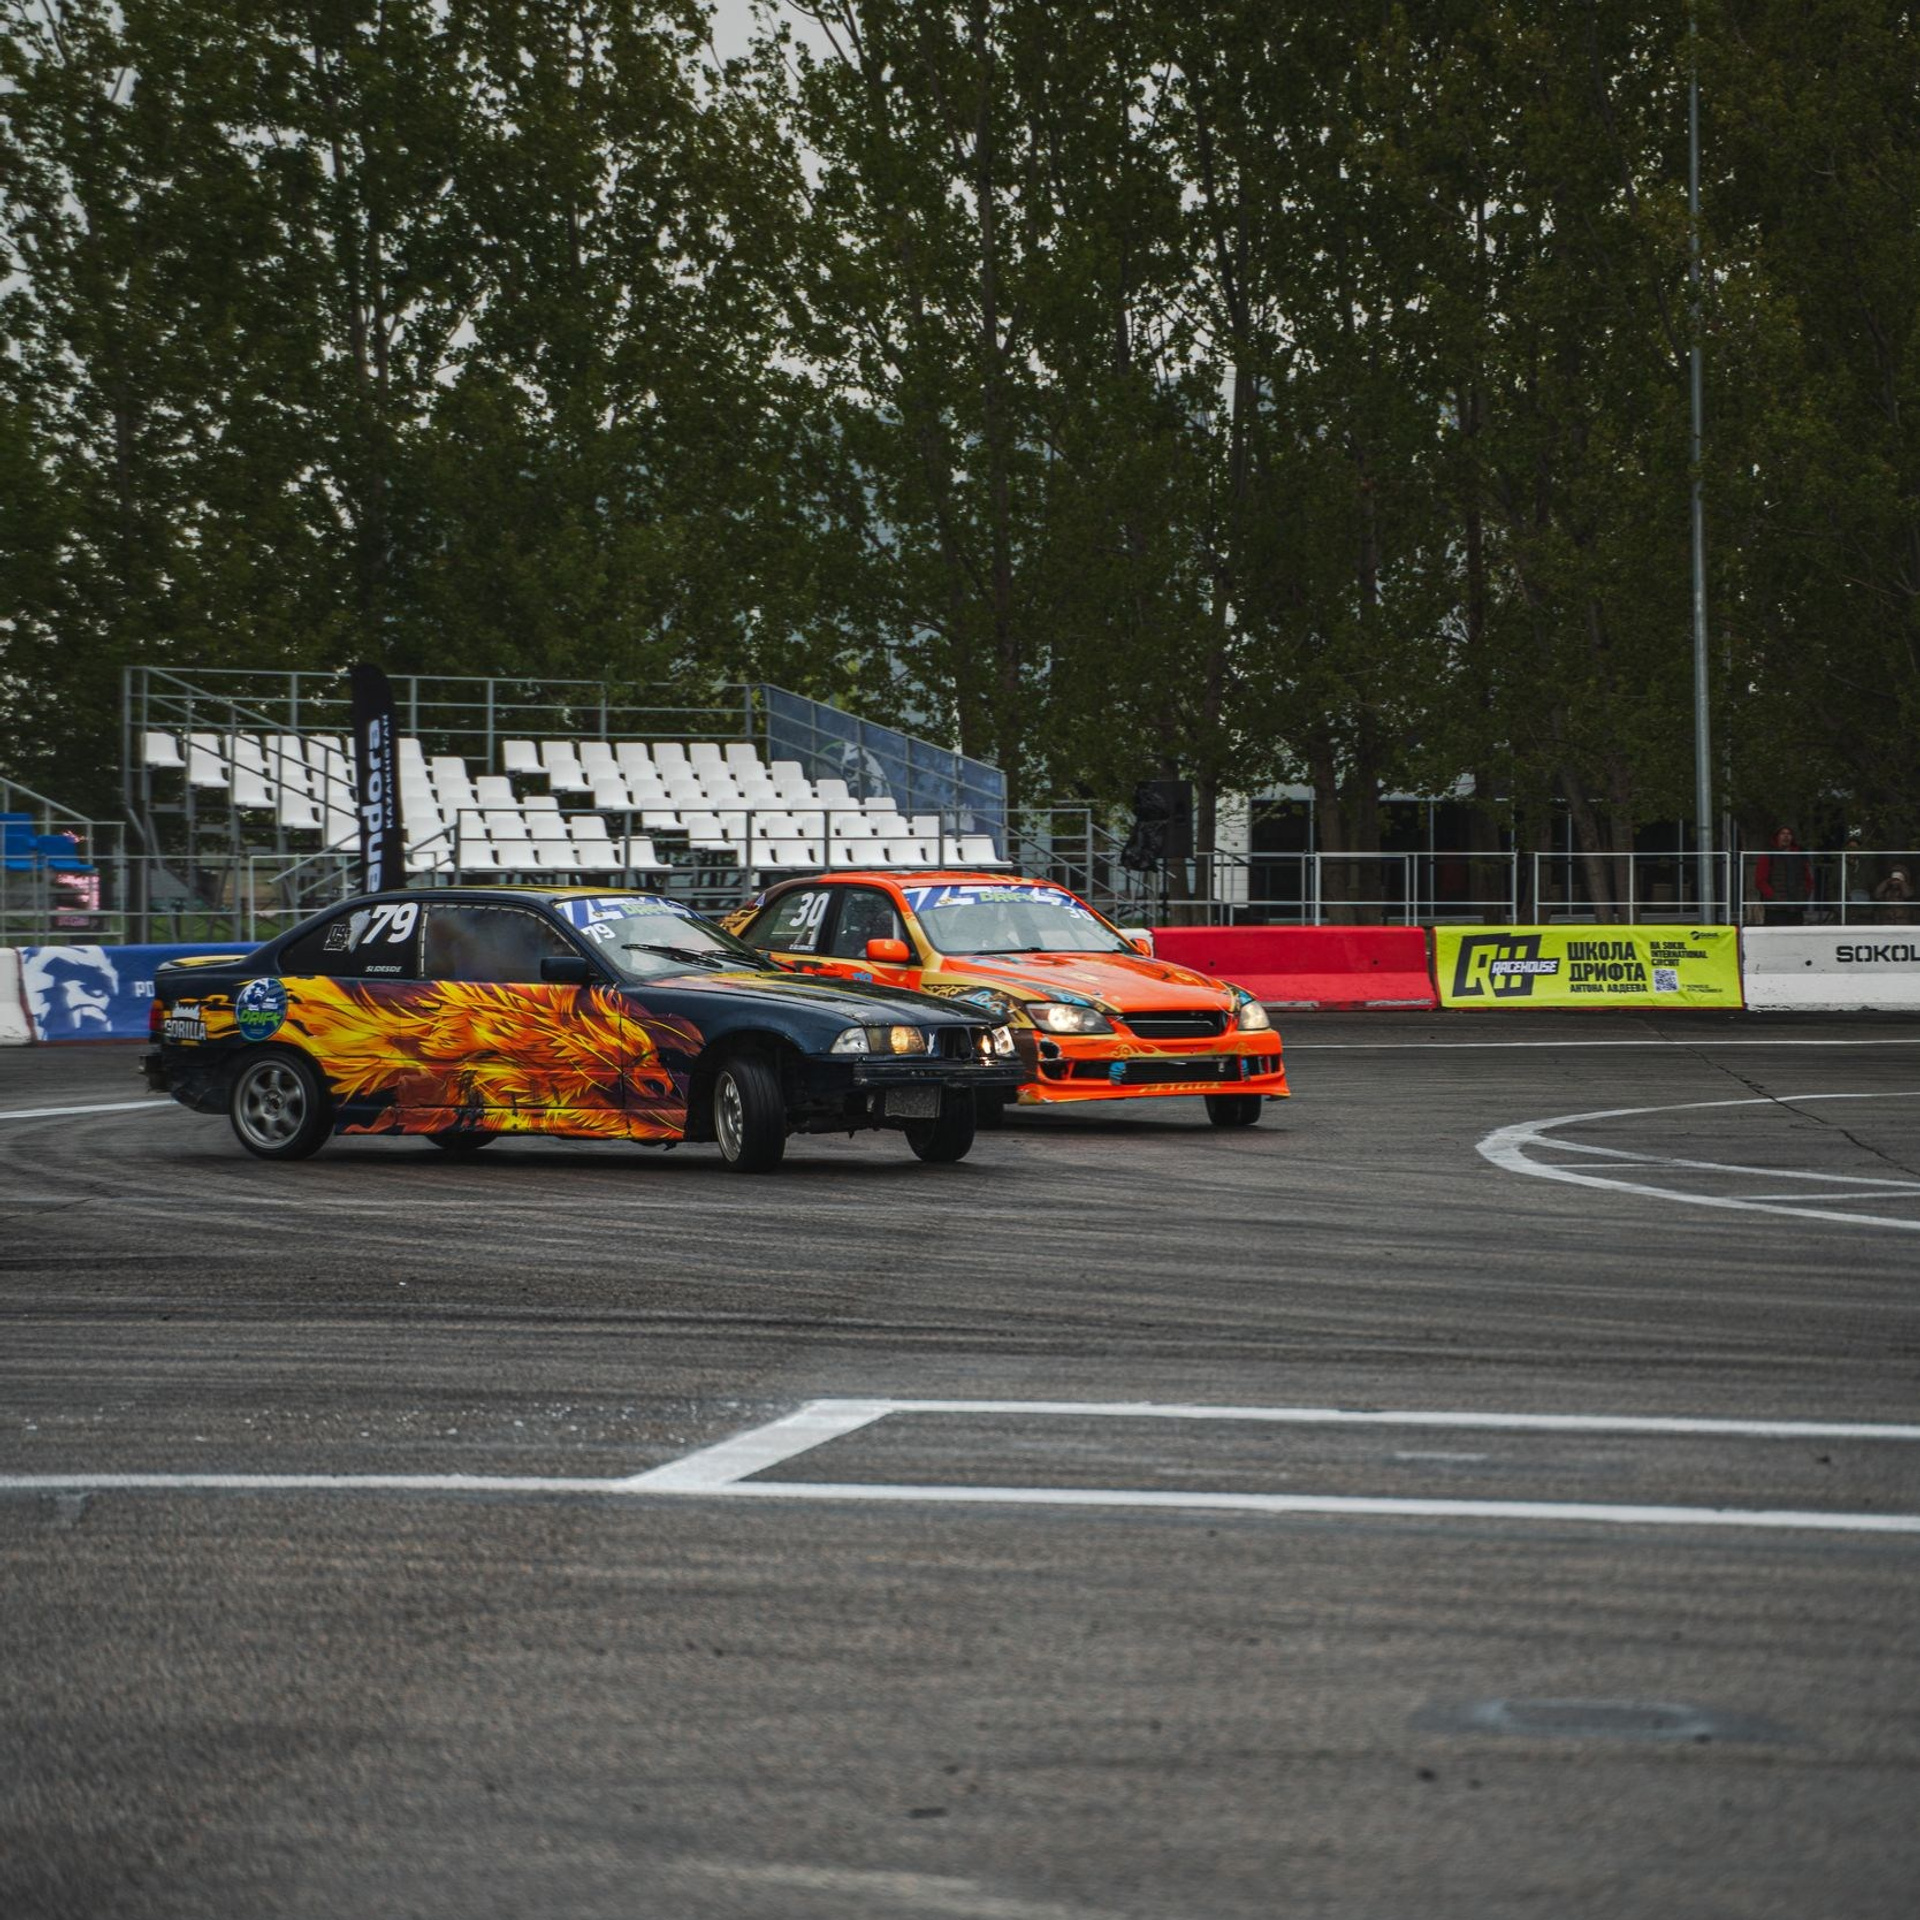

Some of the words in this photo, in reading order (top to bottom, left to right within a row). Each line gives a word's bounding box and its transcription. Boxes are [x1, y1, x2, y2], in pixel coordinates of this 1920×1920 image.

[382, 714, 392, 828] KAZAKHSTAN
[789, 892, 830, 927] 30
[1064, 906, 1096, 921] 30
[361, 902, 418, 944] 79
[580, 923, 616, 944] 79
[1567, 941, 1637, 961] ШКОЛА
[1836, 945, 1920, 962] SOKOL
[1492, 961, 1558, 974] RACEHOUSE
[1569, 963, 1647, 982] ДРИФТА
[1570, 984, 1604, 993] АНТОНА
[1607, 984, 1648, 994] АВДЕЕВА
[164, 1020, 207, 1041] GORILLA
